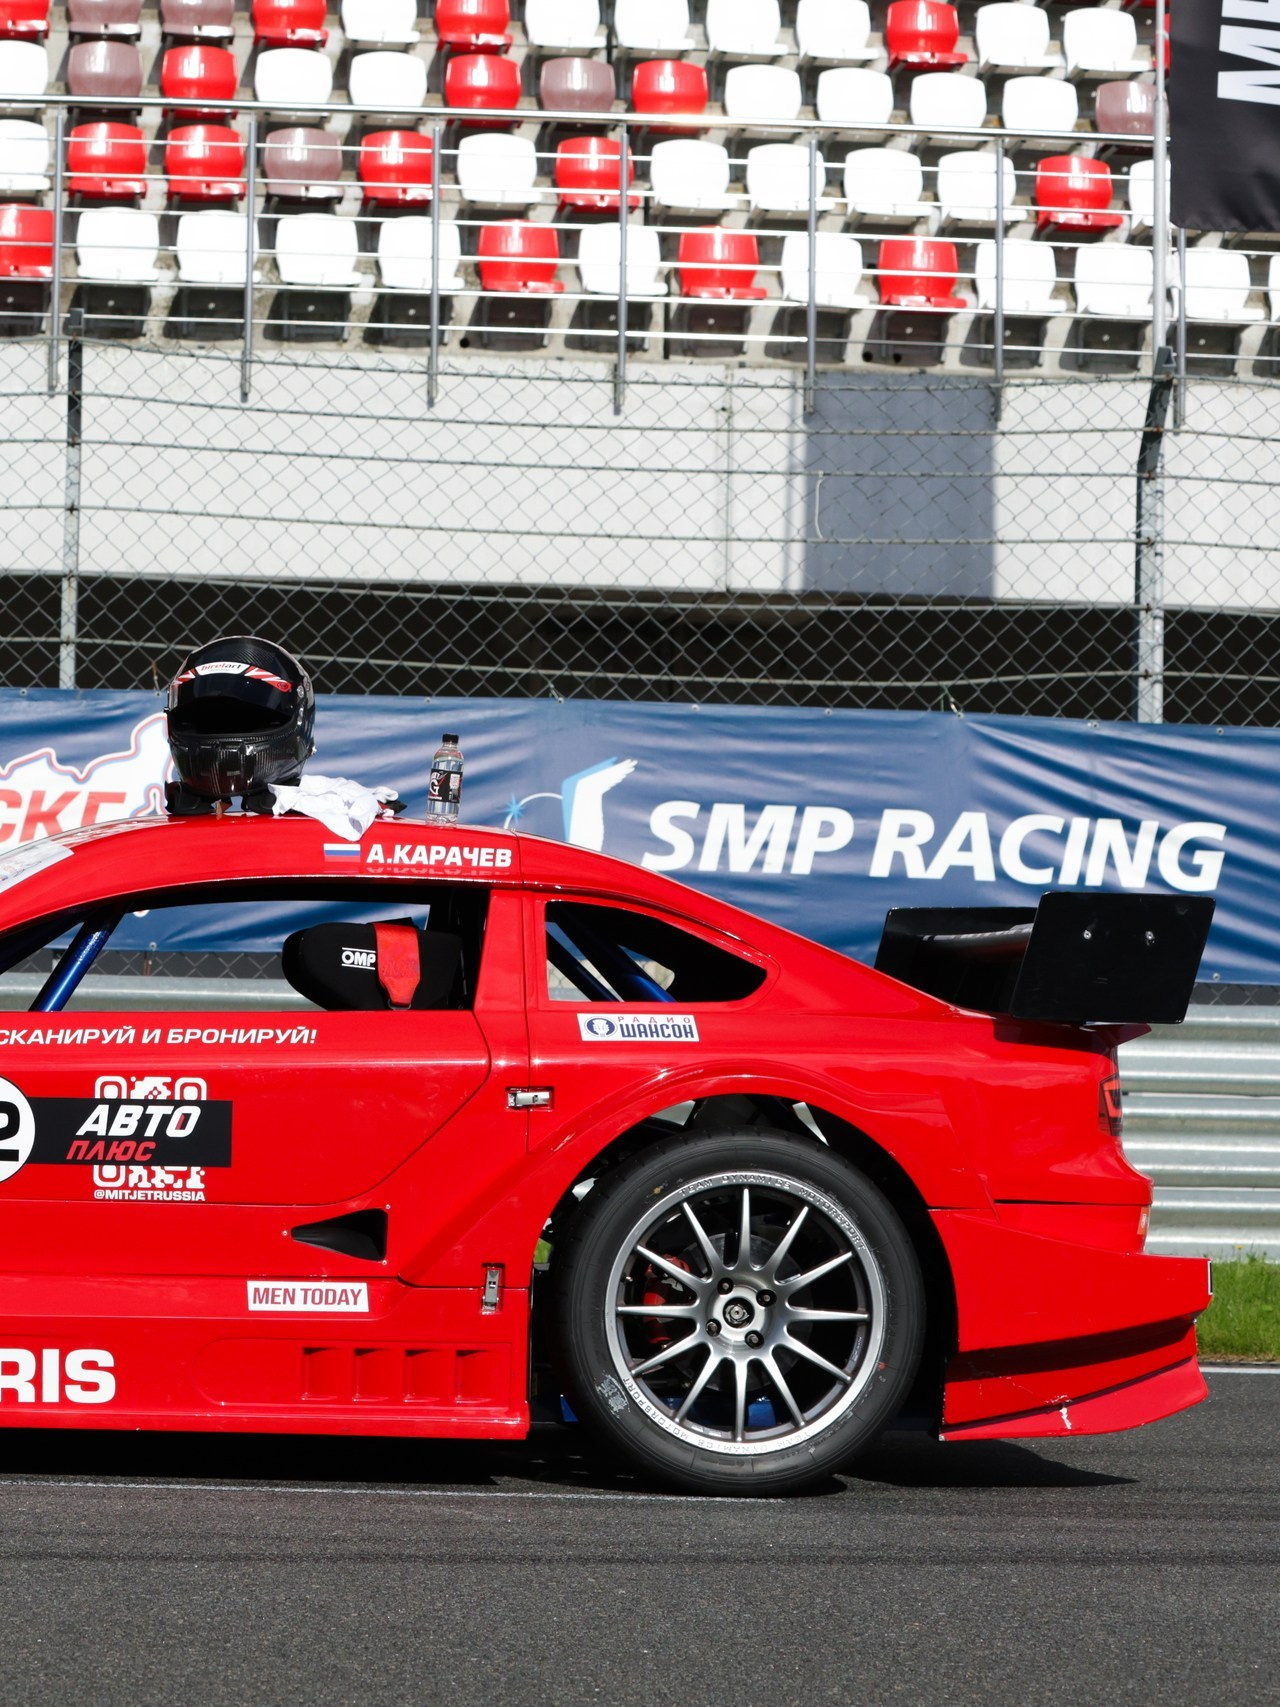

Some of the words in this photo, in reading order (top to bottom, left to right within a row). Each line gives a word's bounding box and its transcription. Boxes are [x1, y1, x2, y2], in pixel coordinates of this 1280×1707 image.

[641, 800, 855, 875] SMP
[869, 808, 1227, 892] RACING
[366, 843, 512, 868] А.КАРАЧЕВ
[341, 950, 376, 967] OMP
[617, 1016, 691, 1024] РАДИО
[141, 1029, 160, 1044] И
[166, 1026, 317, 1044] БРОНИРУЙ!
[620, 1023, 695, 1038] ШАНСОН
[75, 1104, 202, 1138] АВТО
[65, 1140, 157, 1161] ПЛЮС
[93, 1189, 206, 1201] @MITJETRUSSIA
[252, 1287, 296, 1305] MEN
[299, 1288, 362, 1306] TODAY
